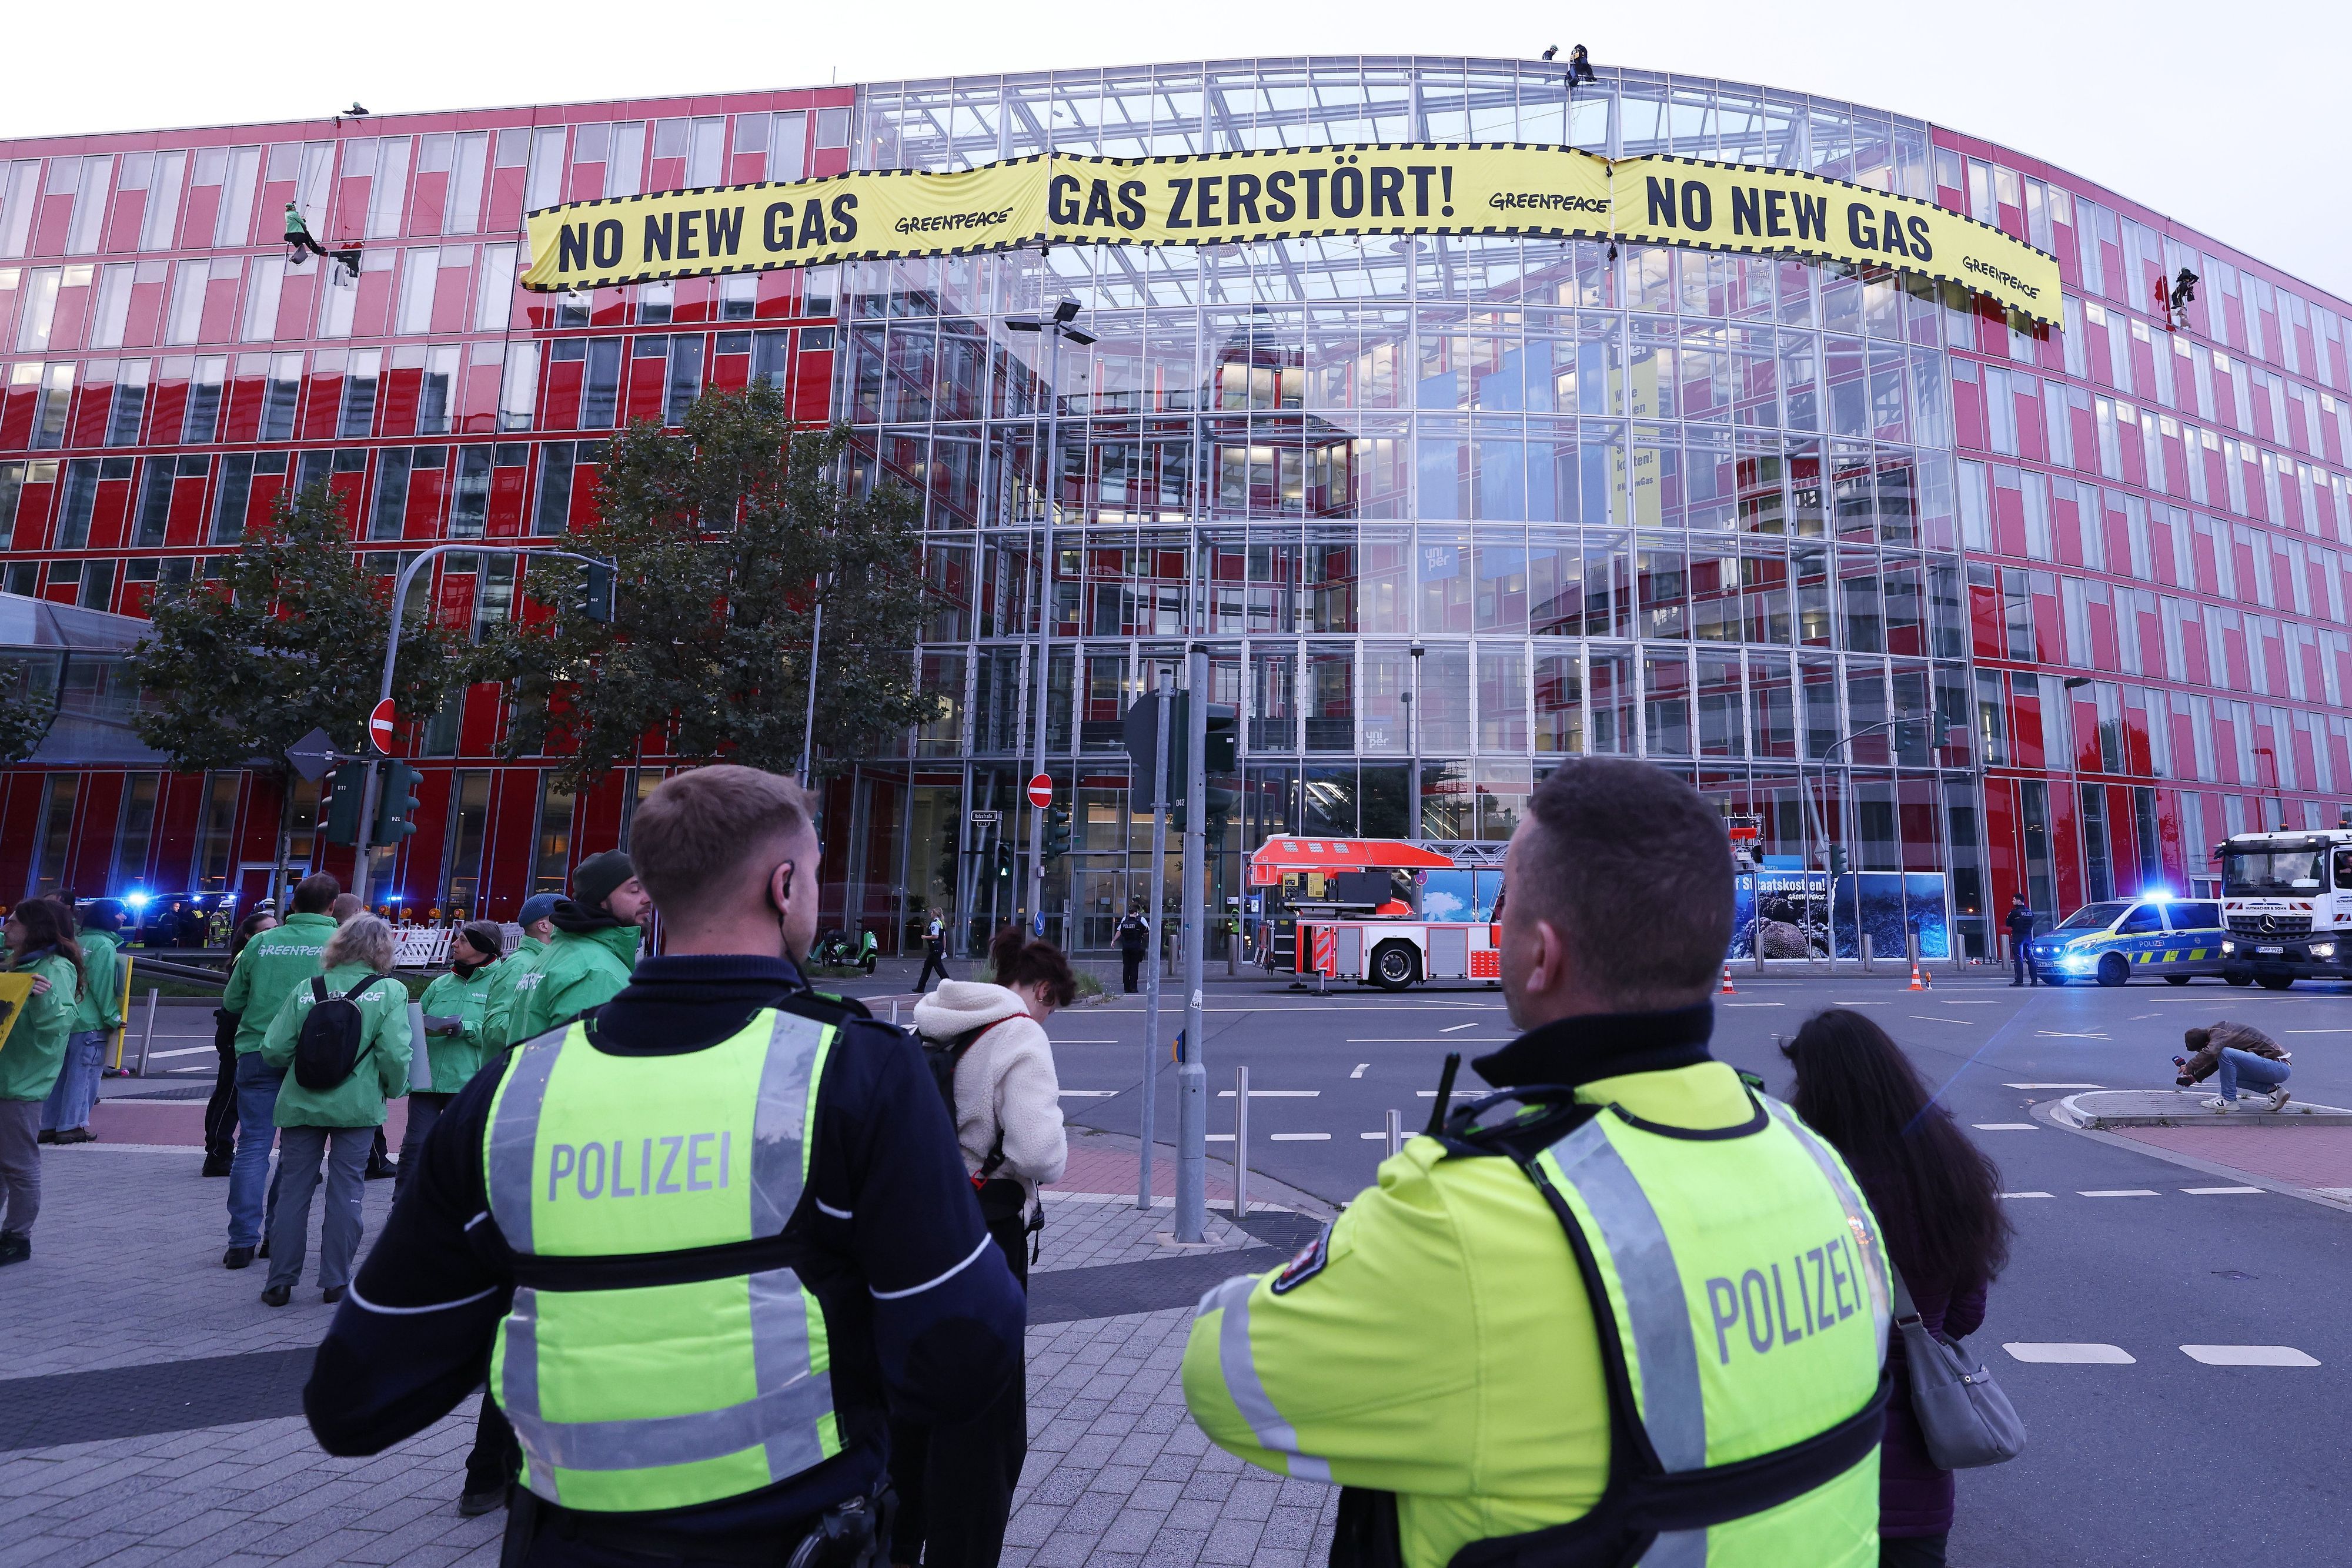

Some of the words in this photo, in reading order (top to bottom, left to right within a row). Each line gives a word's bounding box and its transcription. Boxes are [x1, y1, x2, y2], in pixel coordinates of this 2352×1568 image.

[1049, 174, 1147, 230] GAS
[1163, 156, 1454, 229] ZERSTÖRT!
[1489, 192, 1611, 213] GREENPEACE
[559, 219, 624, 273] NO
[644, 206, 744, 262] NEW
[763, 193, 858, 252] GAS
[894, 207, 1013, 235] GREENPEACE
[1646, 176, 1712, 232] NO
[1732, 185, 1827, 242] NEW
[1847, 203, 1933, 262] GAS
[1962, 255, 2040, 299] GREENPEACE
[1429, 555, 1449, 571] per
[1365, 728, 1382, 738] uni
[1369, 738, 1389, 748] per
[1176, 798, 1185, 807] 042
[258, 944, 323, 957] GREENPEA
[549, 1131, 731, 1201] POLIZEI
[1706, 1235, 1862, 1366] POLIZEI
